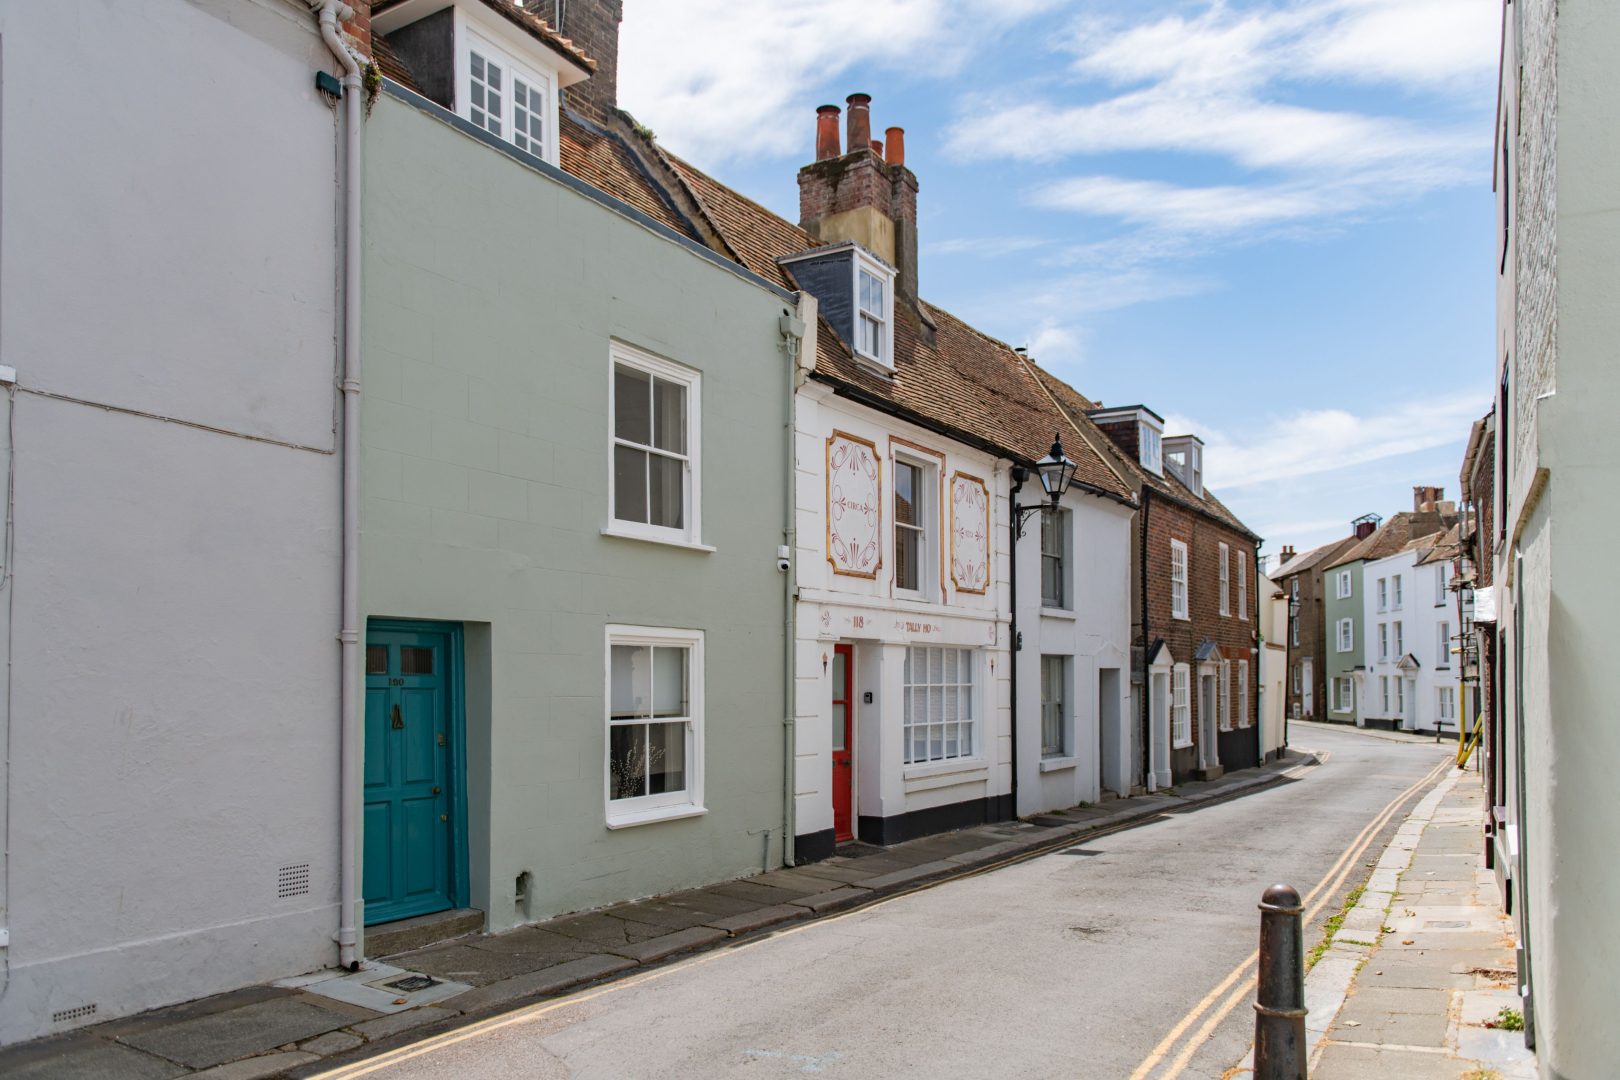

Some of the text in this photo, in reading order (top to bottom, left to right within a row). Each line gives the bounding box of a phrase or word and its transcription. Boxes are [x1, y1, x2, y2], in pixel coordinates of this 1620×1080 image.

[847, 501, 864, 512] CIRCA
[853, 616, 865, 629] 118
[905, 622, 932, 634] TALLY HO
